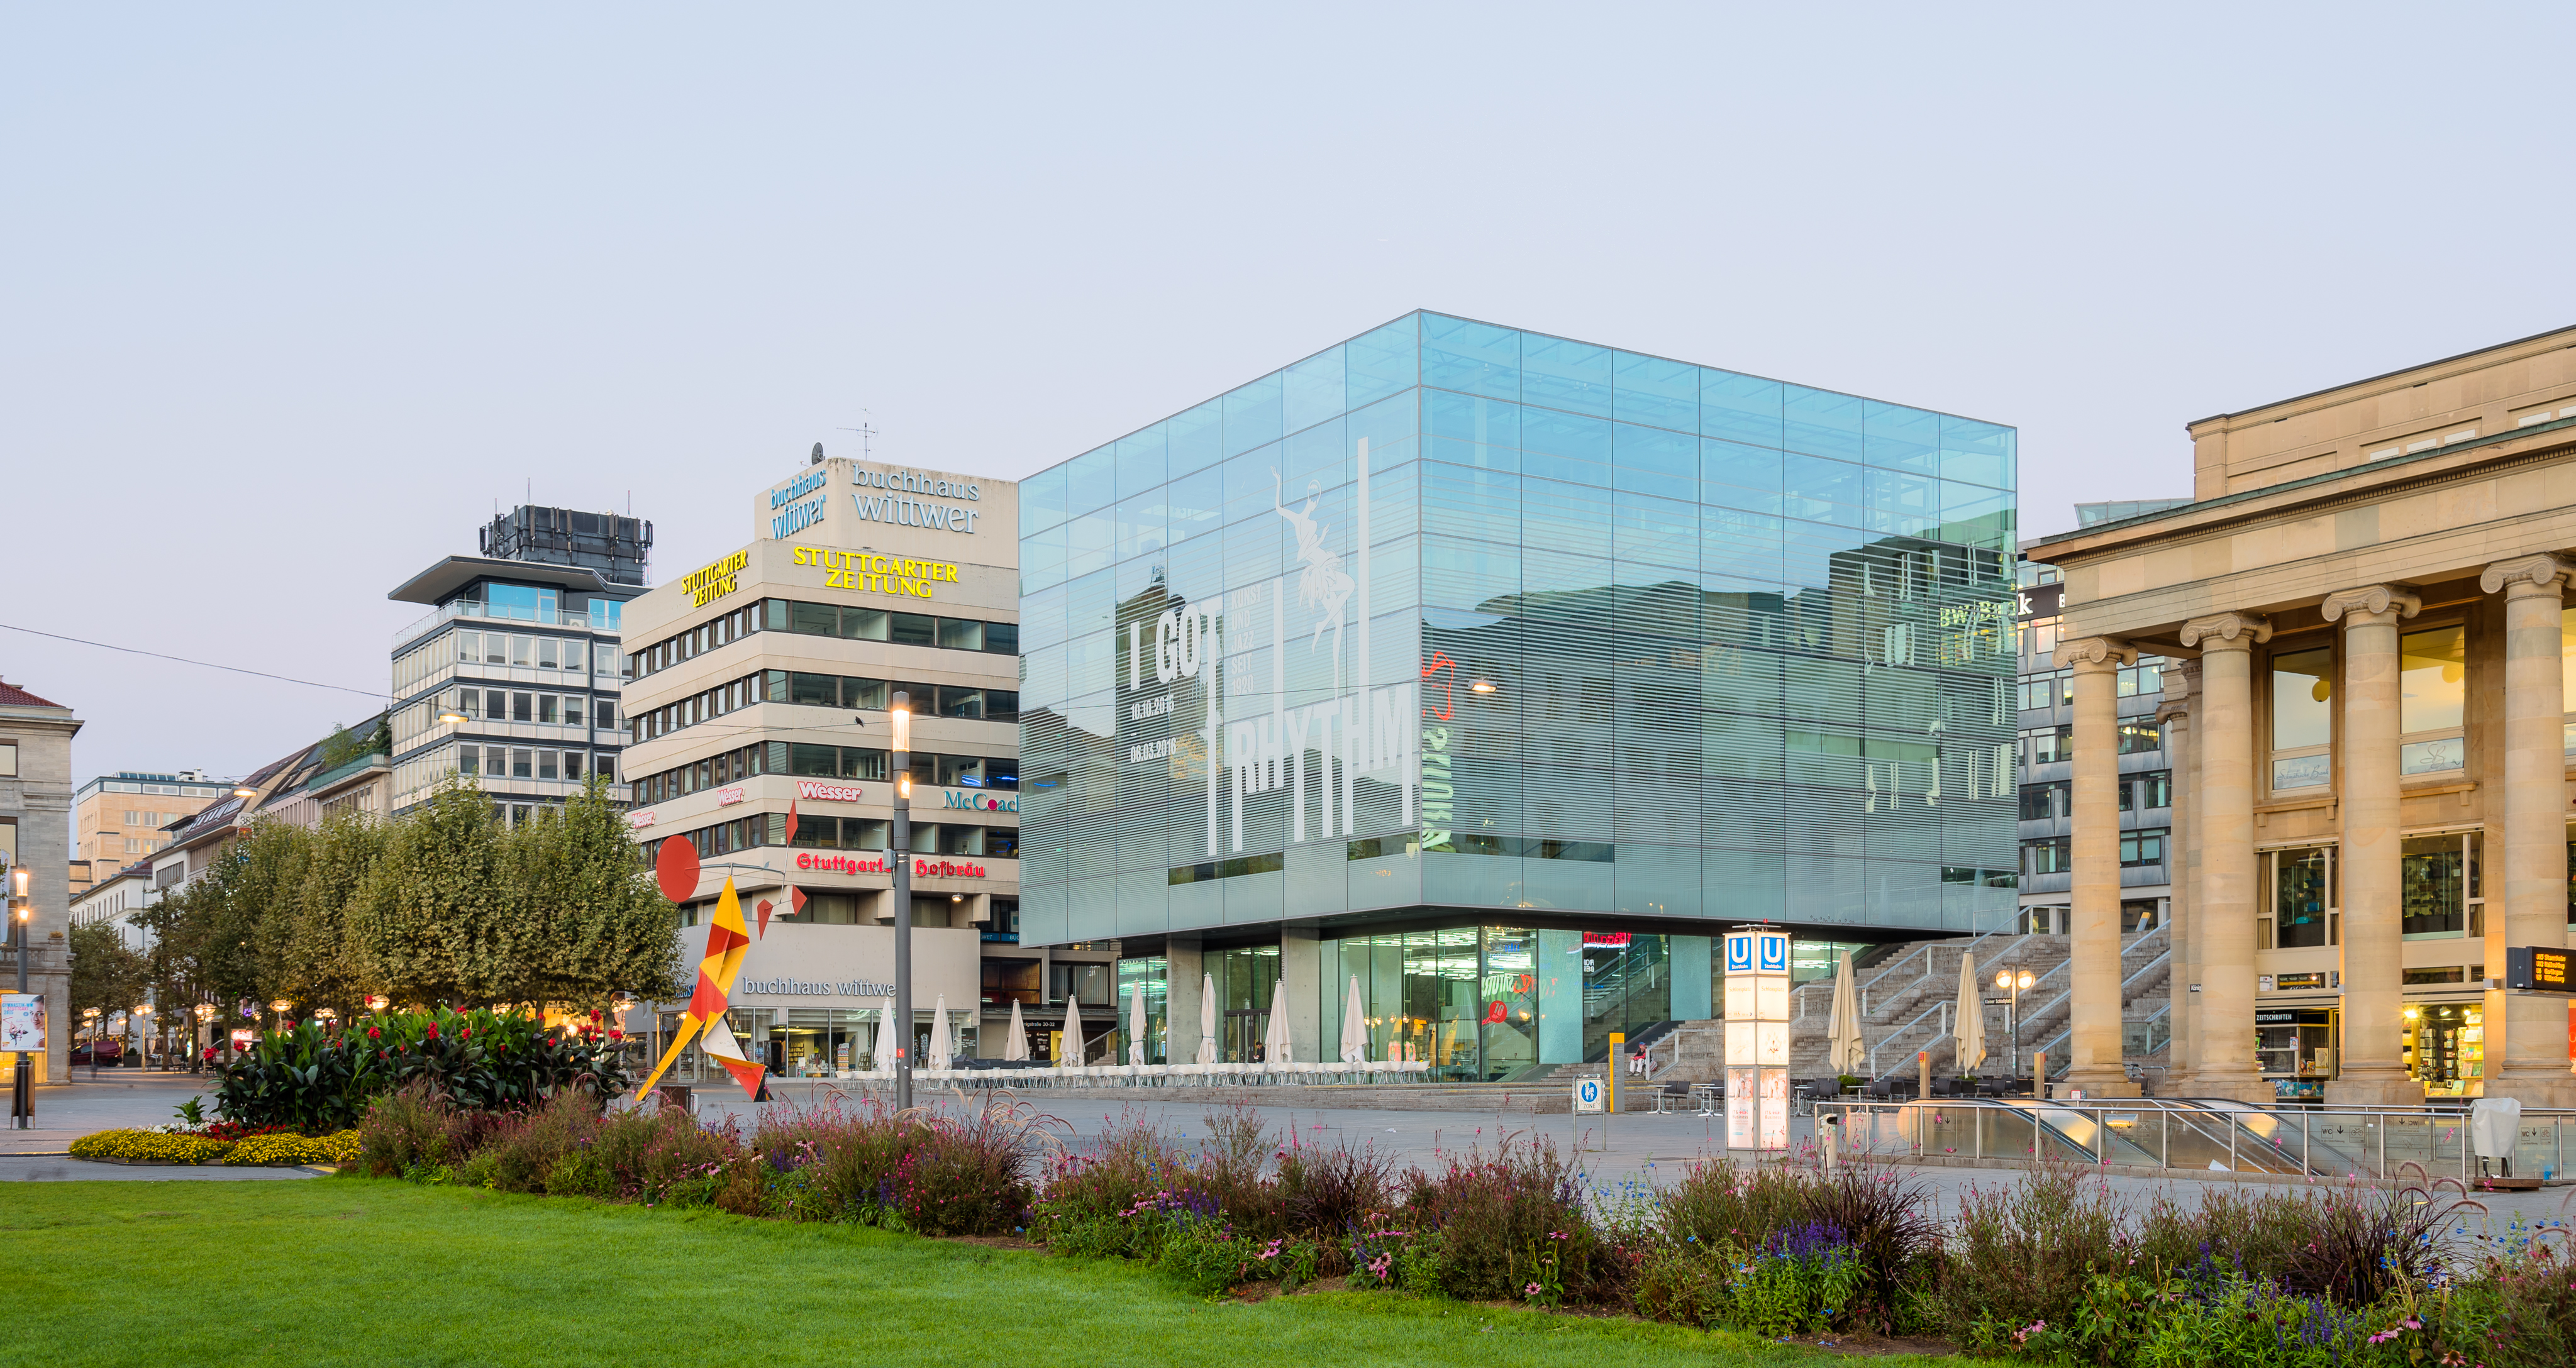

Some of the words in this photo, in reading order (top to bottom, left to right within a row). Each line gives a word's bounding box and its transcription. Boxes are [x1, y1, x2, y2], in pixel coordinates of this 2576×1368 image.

[770, 469, 826, 510] buchhaus
[852, 463, 980, 502] buchhaus
[770, 494, 826, 540] wittwer
[852, 491, 980, 534] wittwer
[681, 549, 748, 595] STUTTGARTER
[793, 546, 959, 583] STUTTGARTER
[692, 574, 737, 608] ZEITUNG
[825, 570, 933, 598] ZEITUNG
[1231, 583, 1265, 611] KUNST
[1231, 609, 1252, 631] UND
[1231, 630, 1255, 652] JAZZ
[1130, 621, 1140, 691] I
[1231, 653, 1253, 675] SEIT
[1231, 673, 1255, 697] 1920
[1130, 693, 1175, 721] 10.10.2015
[1130, 737, 1177, 763] 06.03.2016
[717, 787, 746, 807] Wesser
[797, 781, 862, 802] Wesser
[240, 816, 250, 825] 38
[631, 811, 655, 829] Wesser
[796, 853, 892, 875] Stuttgart
[915, 859, 985, 878] Hofbräu
[1731, 939, 1748, 963] U
[1764, 938, 1782, 963] U
[743, 976, 831, 995] buchhaus
[836, 979, 896, 997] wittwe
